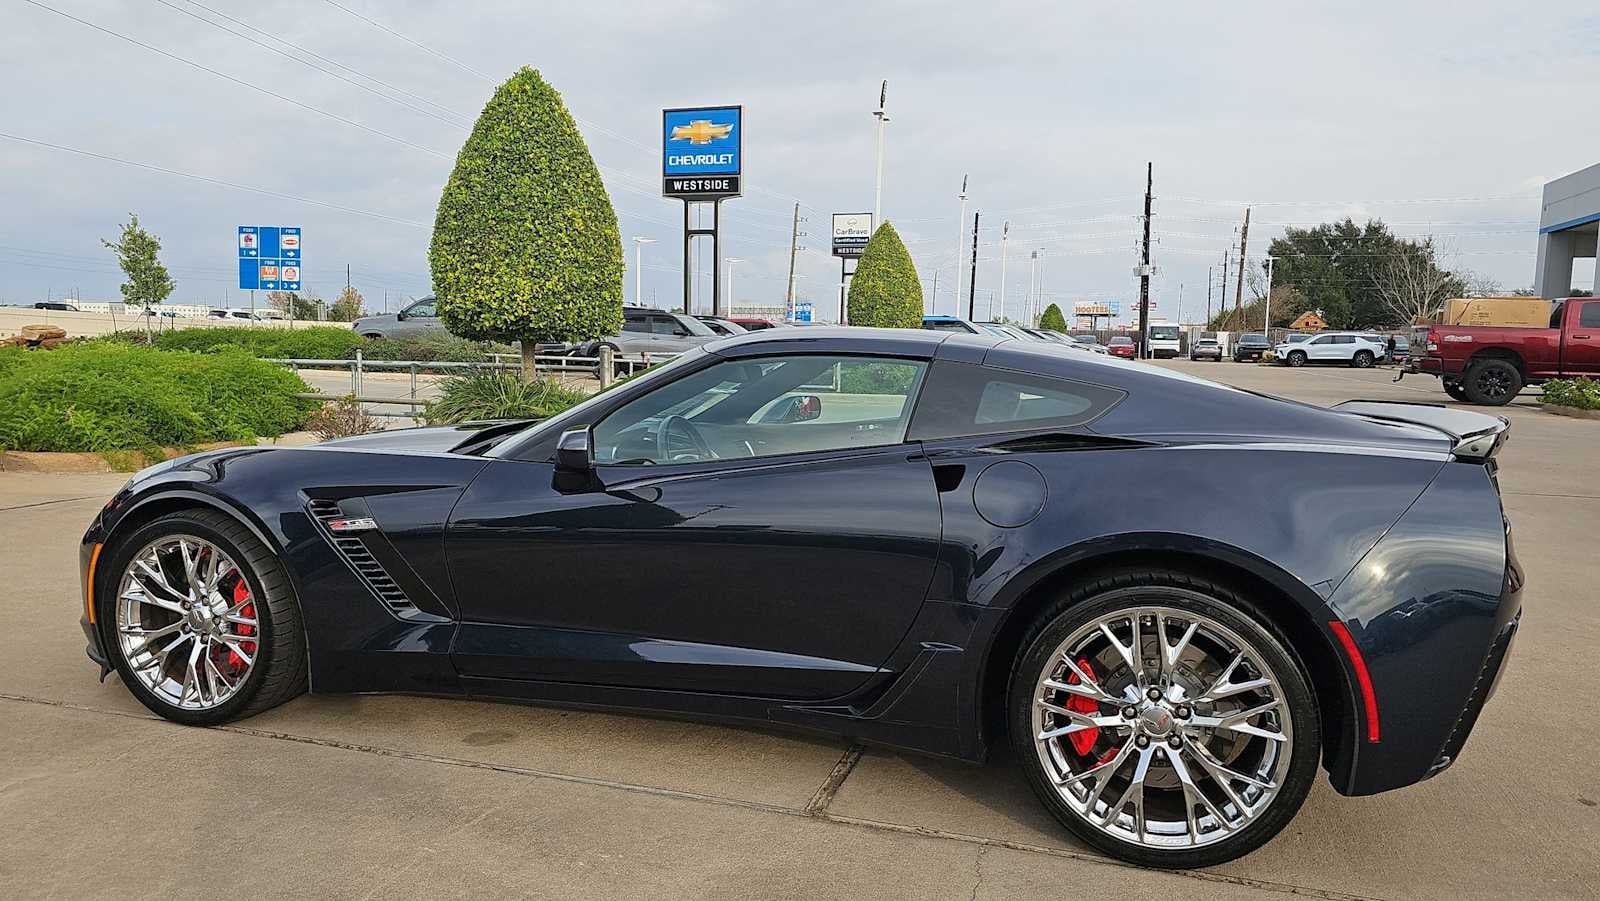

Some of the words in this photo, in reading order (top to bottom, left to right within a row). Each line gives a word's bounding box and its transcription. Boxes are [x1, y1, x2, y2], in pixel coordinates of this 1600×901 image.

[668, 154, 734, 166] CHEVROLET
[673, 180, 729, 190] WESTSIDE
[1075, 305, 1108, 314] HOOTERS
